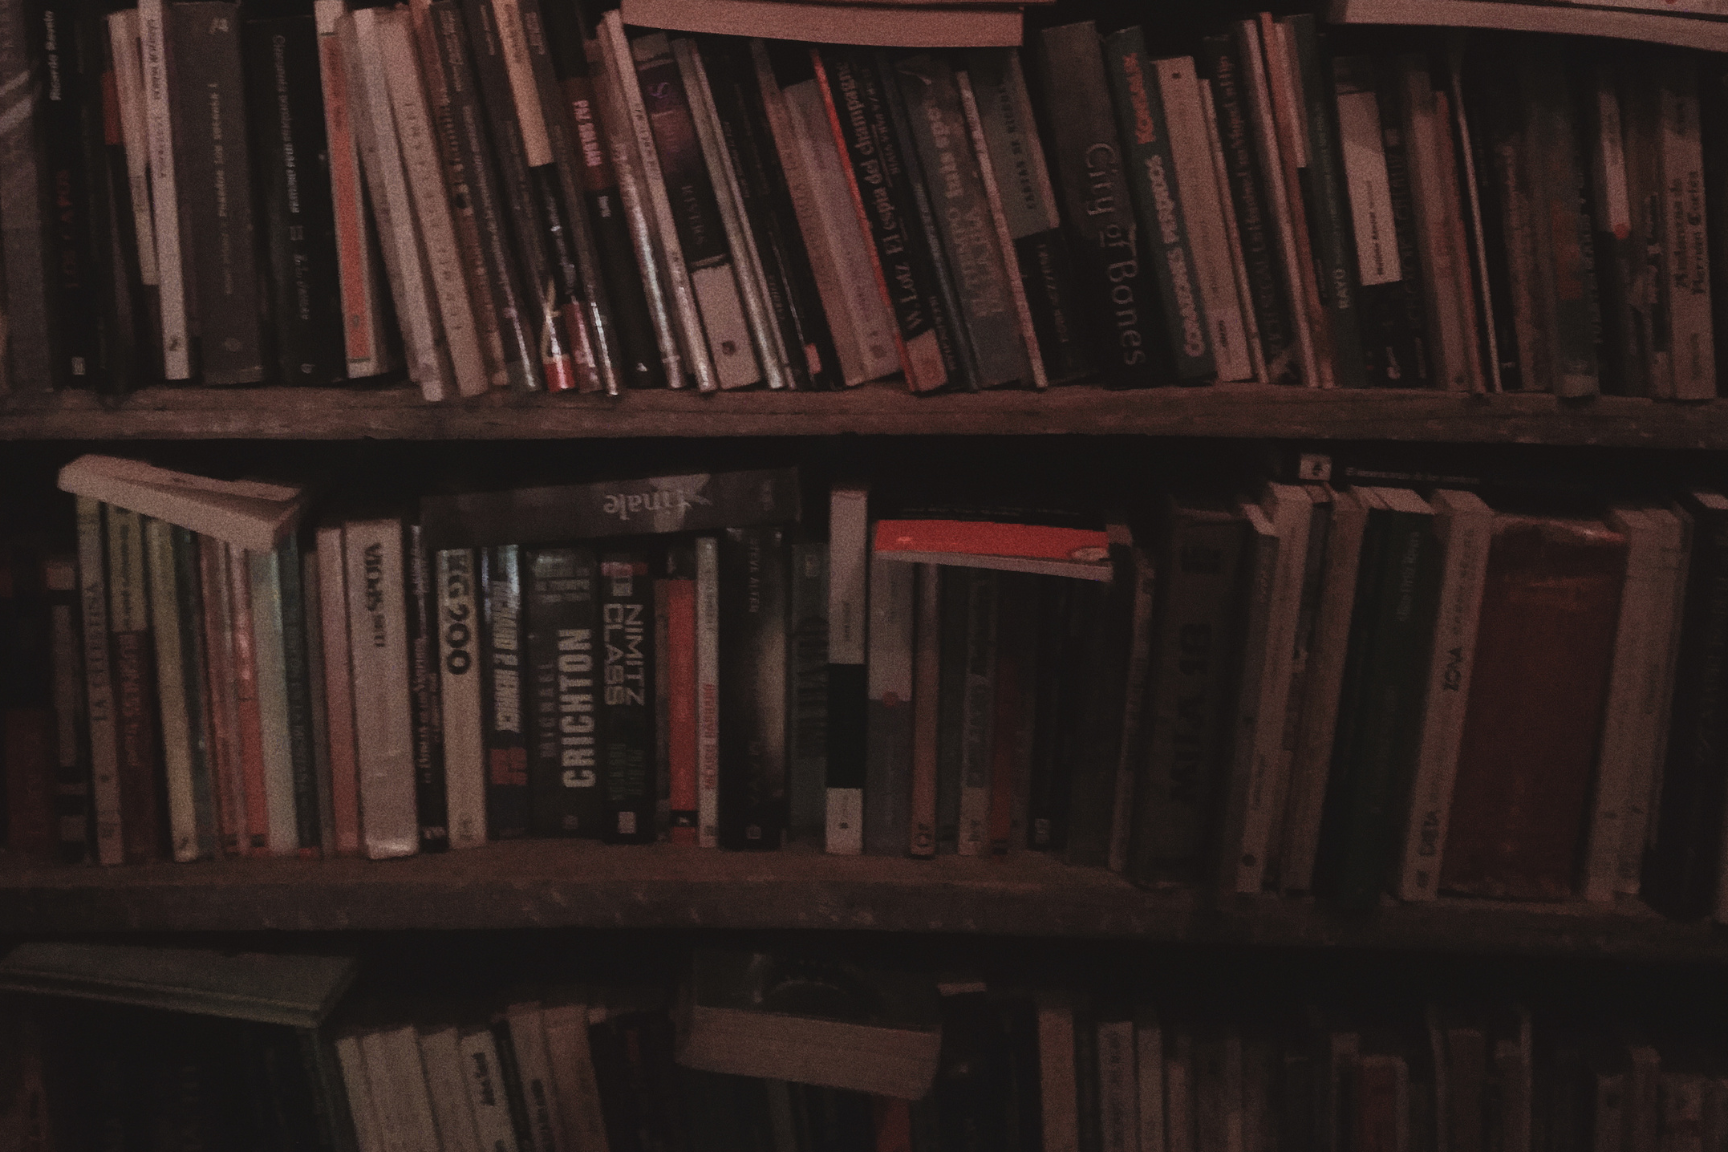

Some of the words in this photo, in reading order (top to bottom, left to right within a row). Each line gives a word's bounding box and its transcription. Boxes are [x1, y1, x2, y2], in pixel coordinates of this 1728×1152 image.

[860, 160, 884, 185] del
[1084, 143, 1118, 216] City
[1100, 224, 1137, 256] of
[1107, 259, 1146, 365] Bones
[364, 543, 385, 611] SPOTA
[447, 605, 471, 675] 200
[603, 604, 622, 705] CLASS
[626, 604, 645, 705] NIMITZ
[1178, 623, 1212, 676] 18
[1443, 647, 1464, 693] ZONA
[537, 661, 554, 759] MICHAEL
[558, 628, 596, 788] CRICHTON
